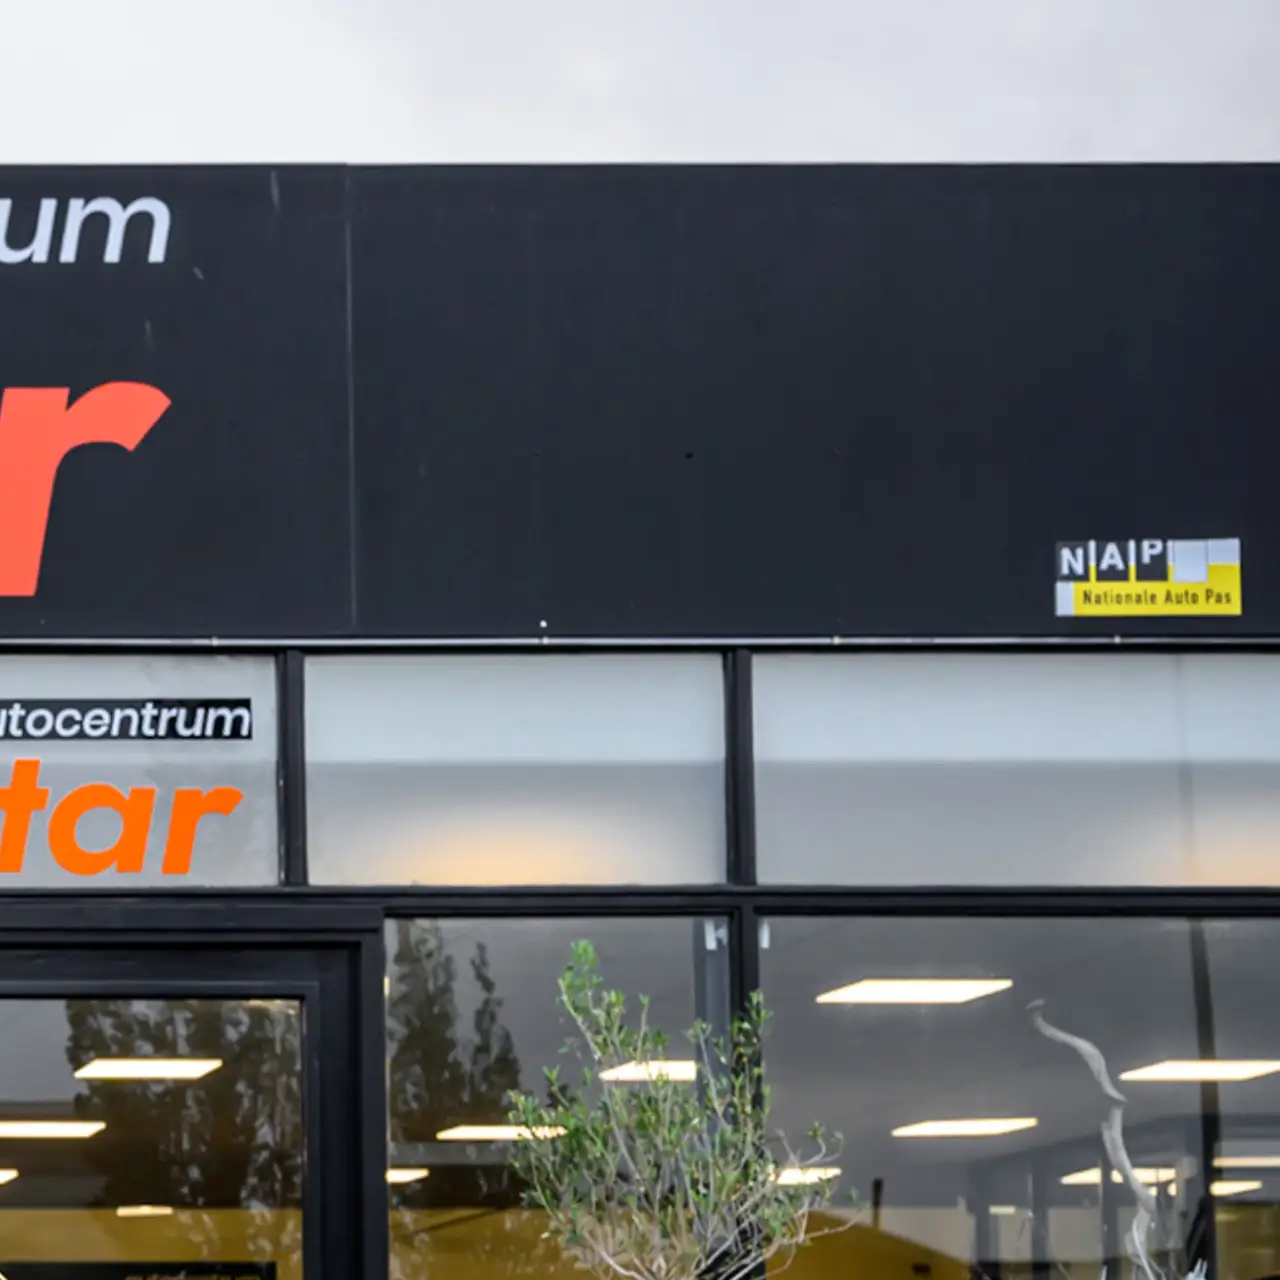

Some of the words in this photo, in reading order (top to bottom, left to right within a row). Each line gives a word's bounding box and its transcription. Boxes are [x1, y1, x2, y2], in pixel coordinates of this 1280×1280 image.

[1082, 589, 1158, 605] Nationale
[1164, 588, 1199, 605] Auto
[1205, 588, 1232, 605] Pas
